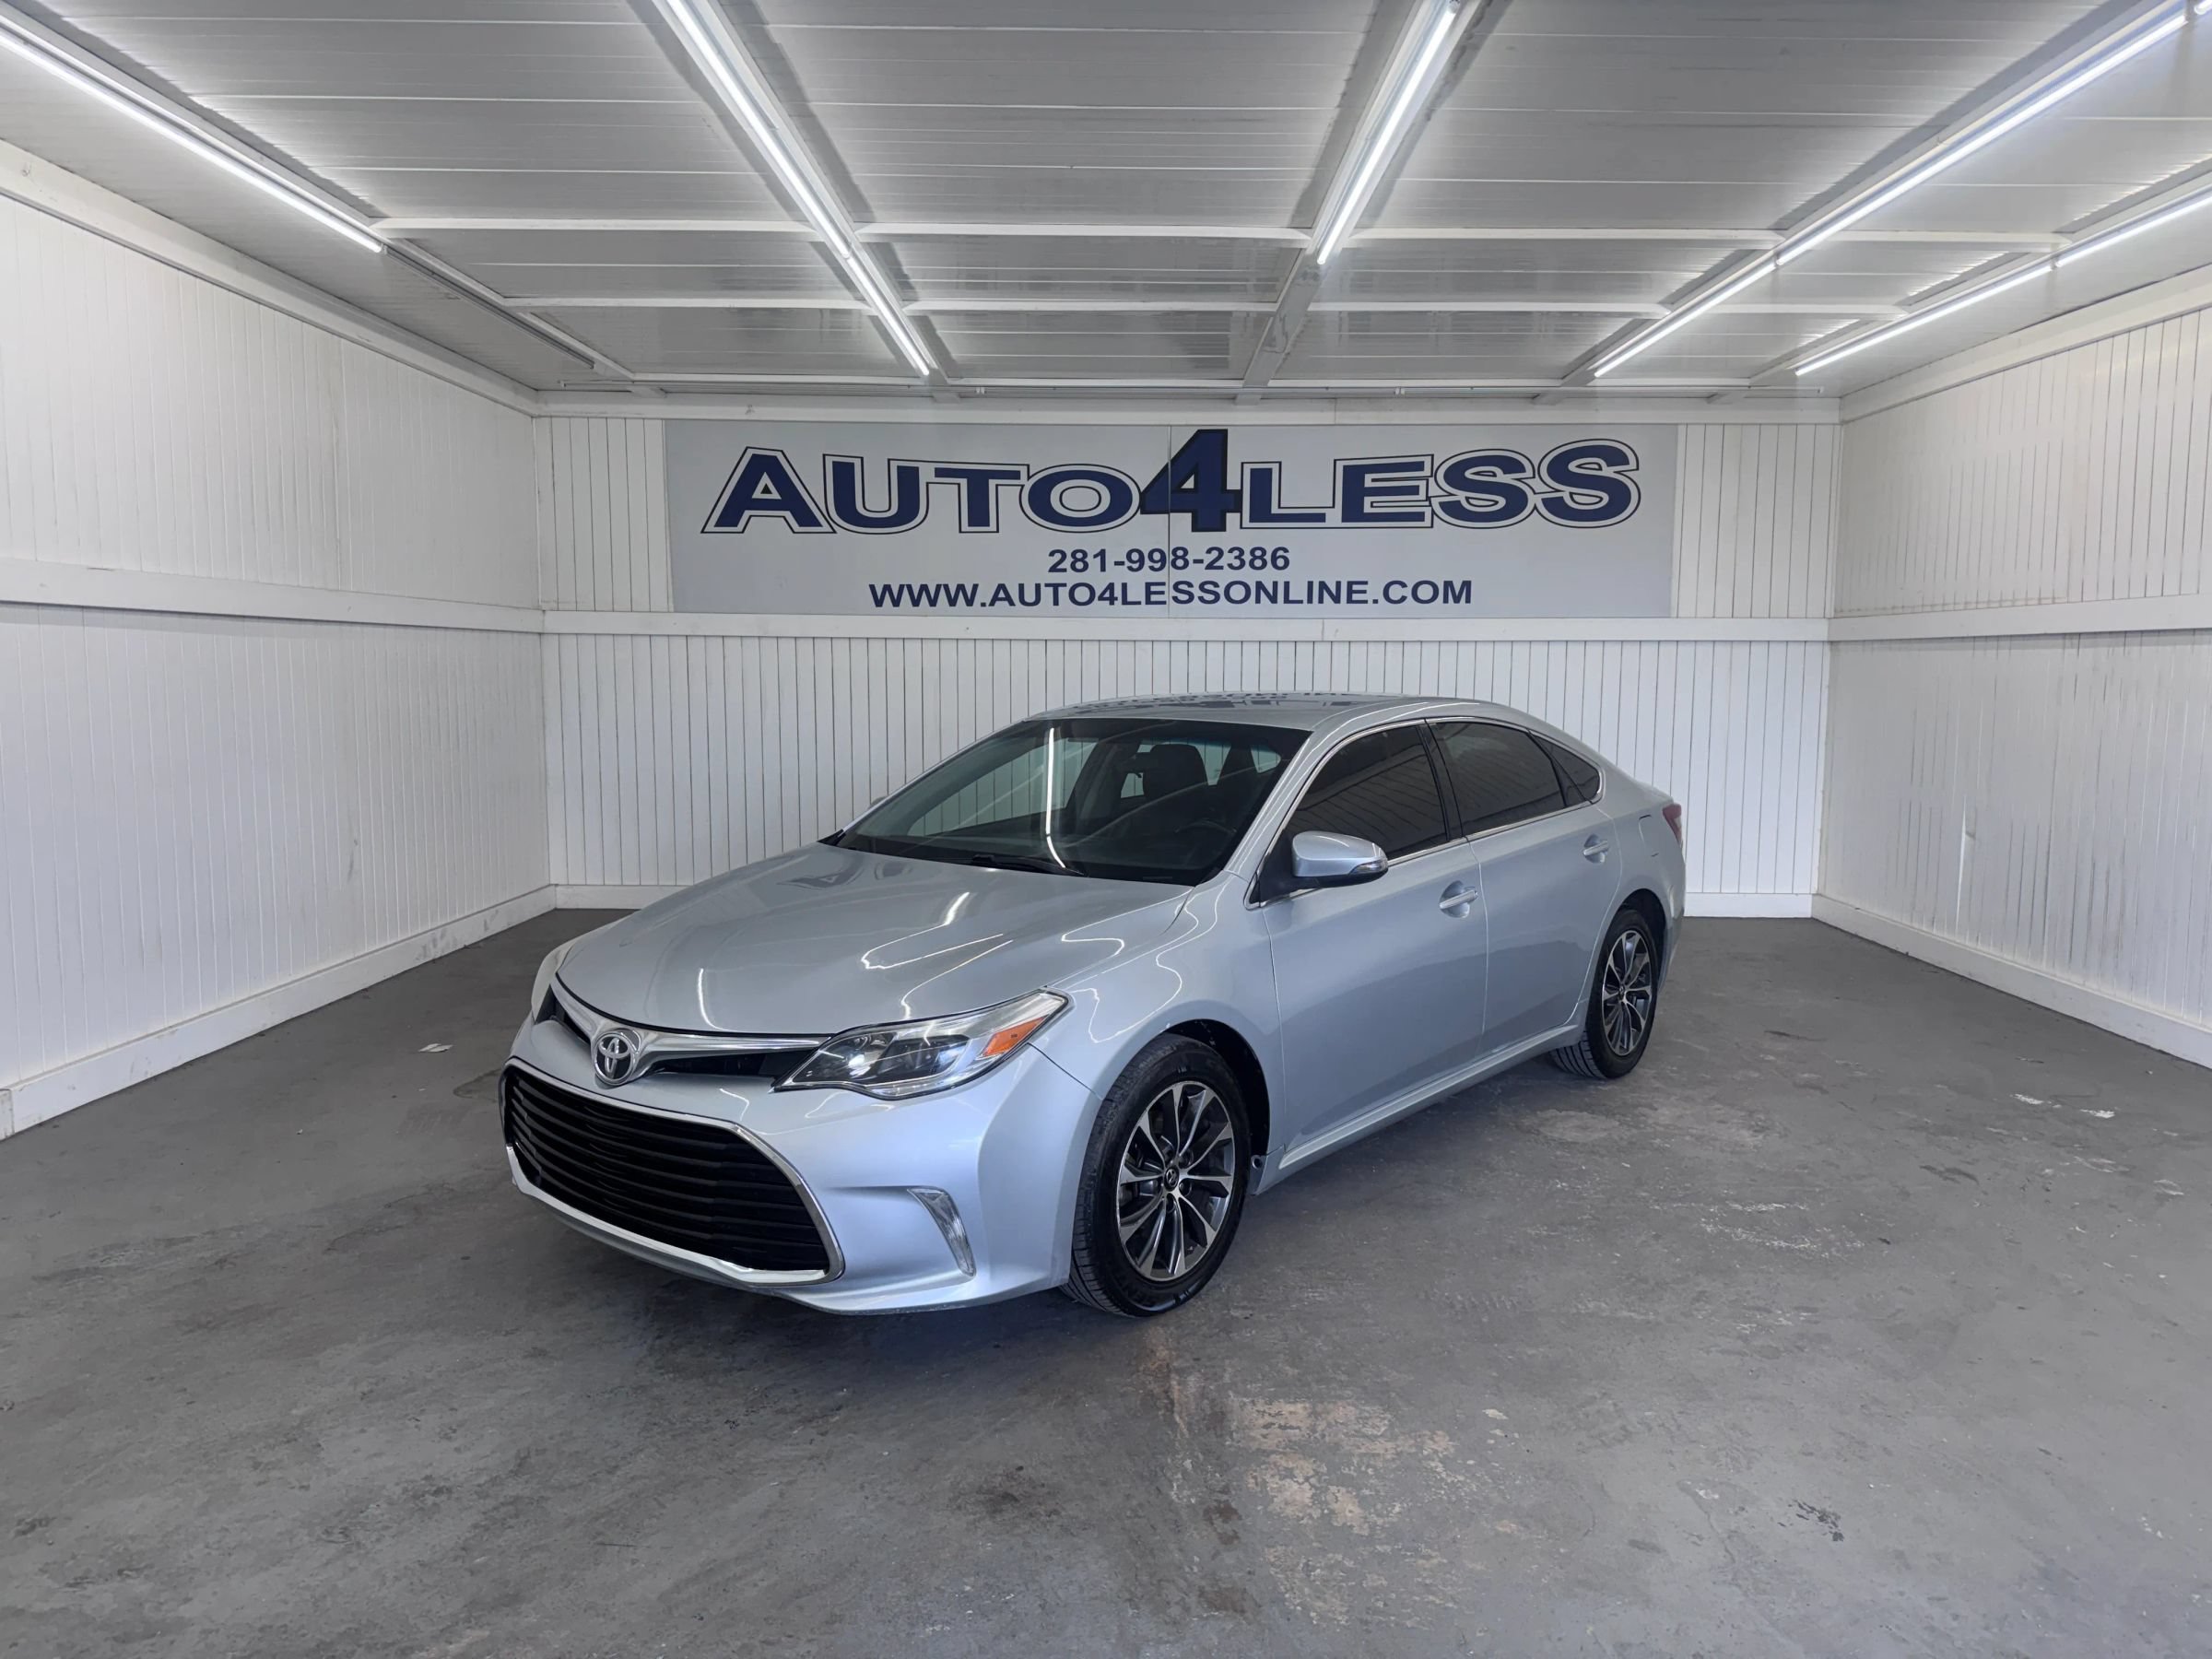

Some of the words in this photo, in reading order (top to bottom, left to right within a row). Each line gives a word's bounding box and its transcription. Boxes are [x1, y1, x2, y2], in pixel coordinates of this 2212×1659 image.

[700, 429, 1641, 534] AUTO4LESS
[1048, 546, 1289, 572] 281-998-2386
[869, 580, 1472, 607] WWW.AUTO4LESSONLINE.COM
